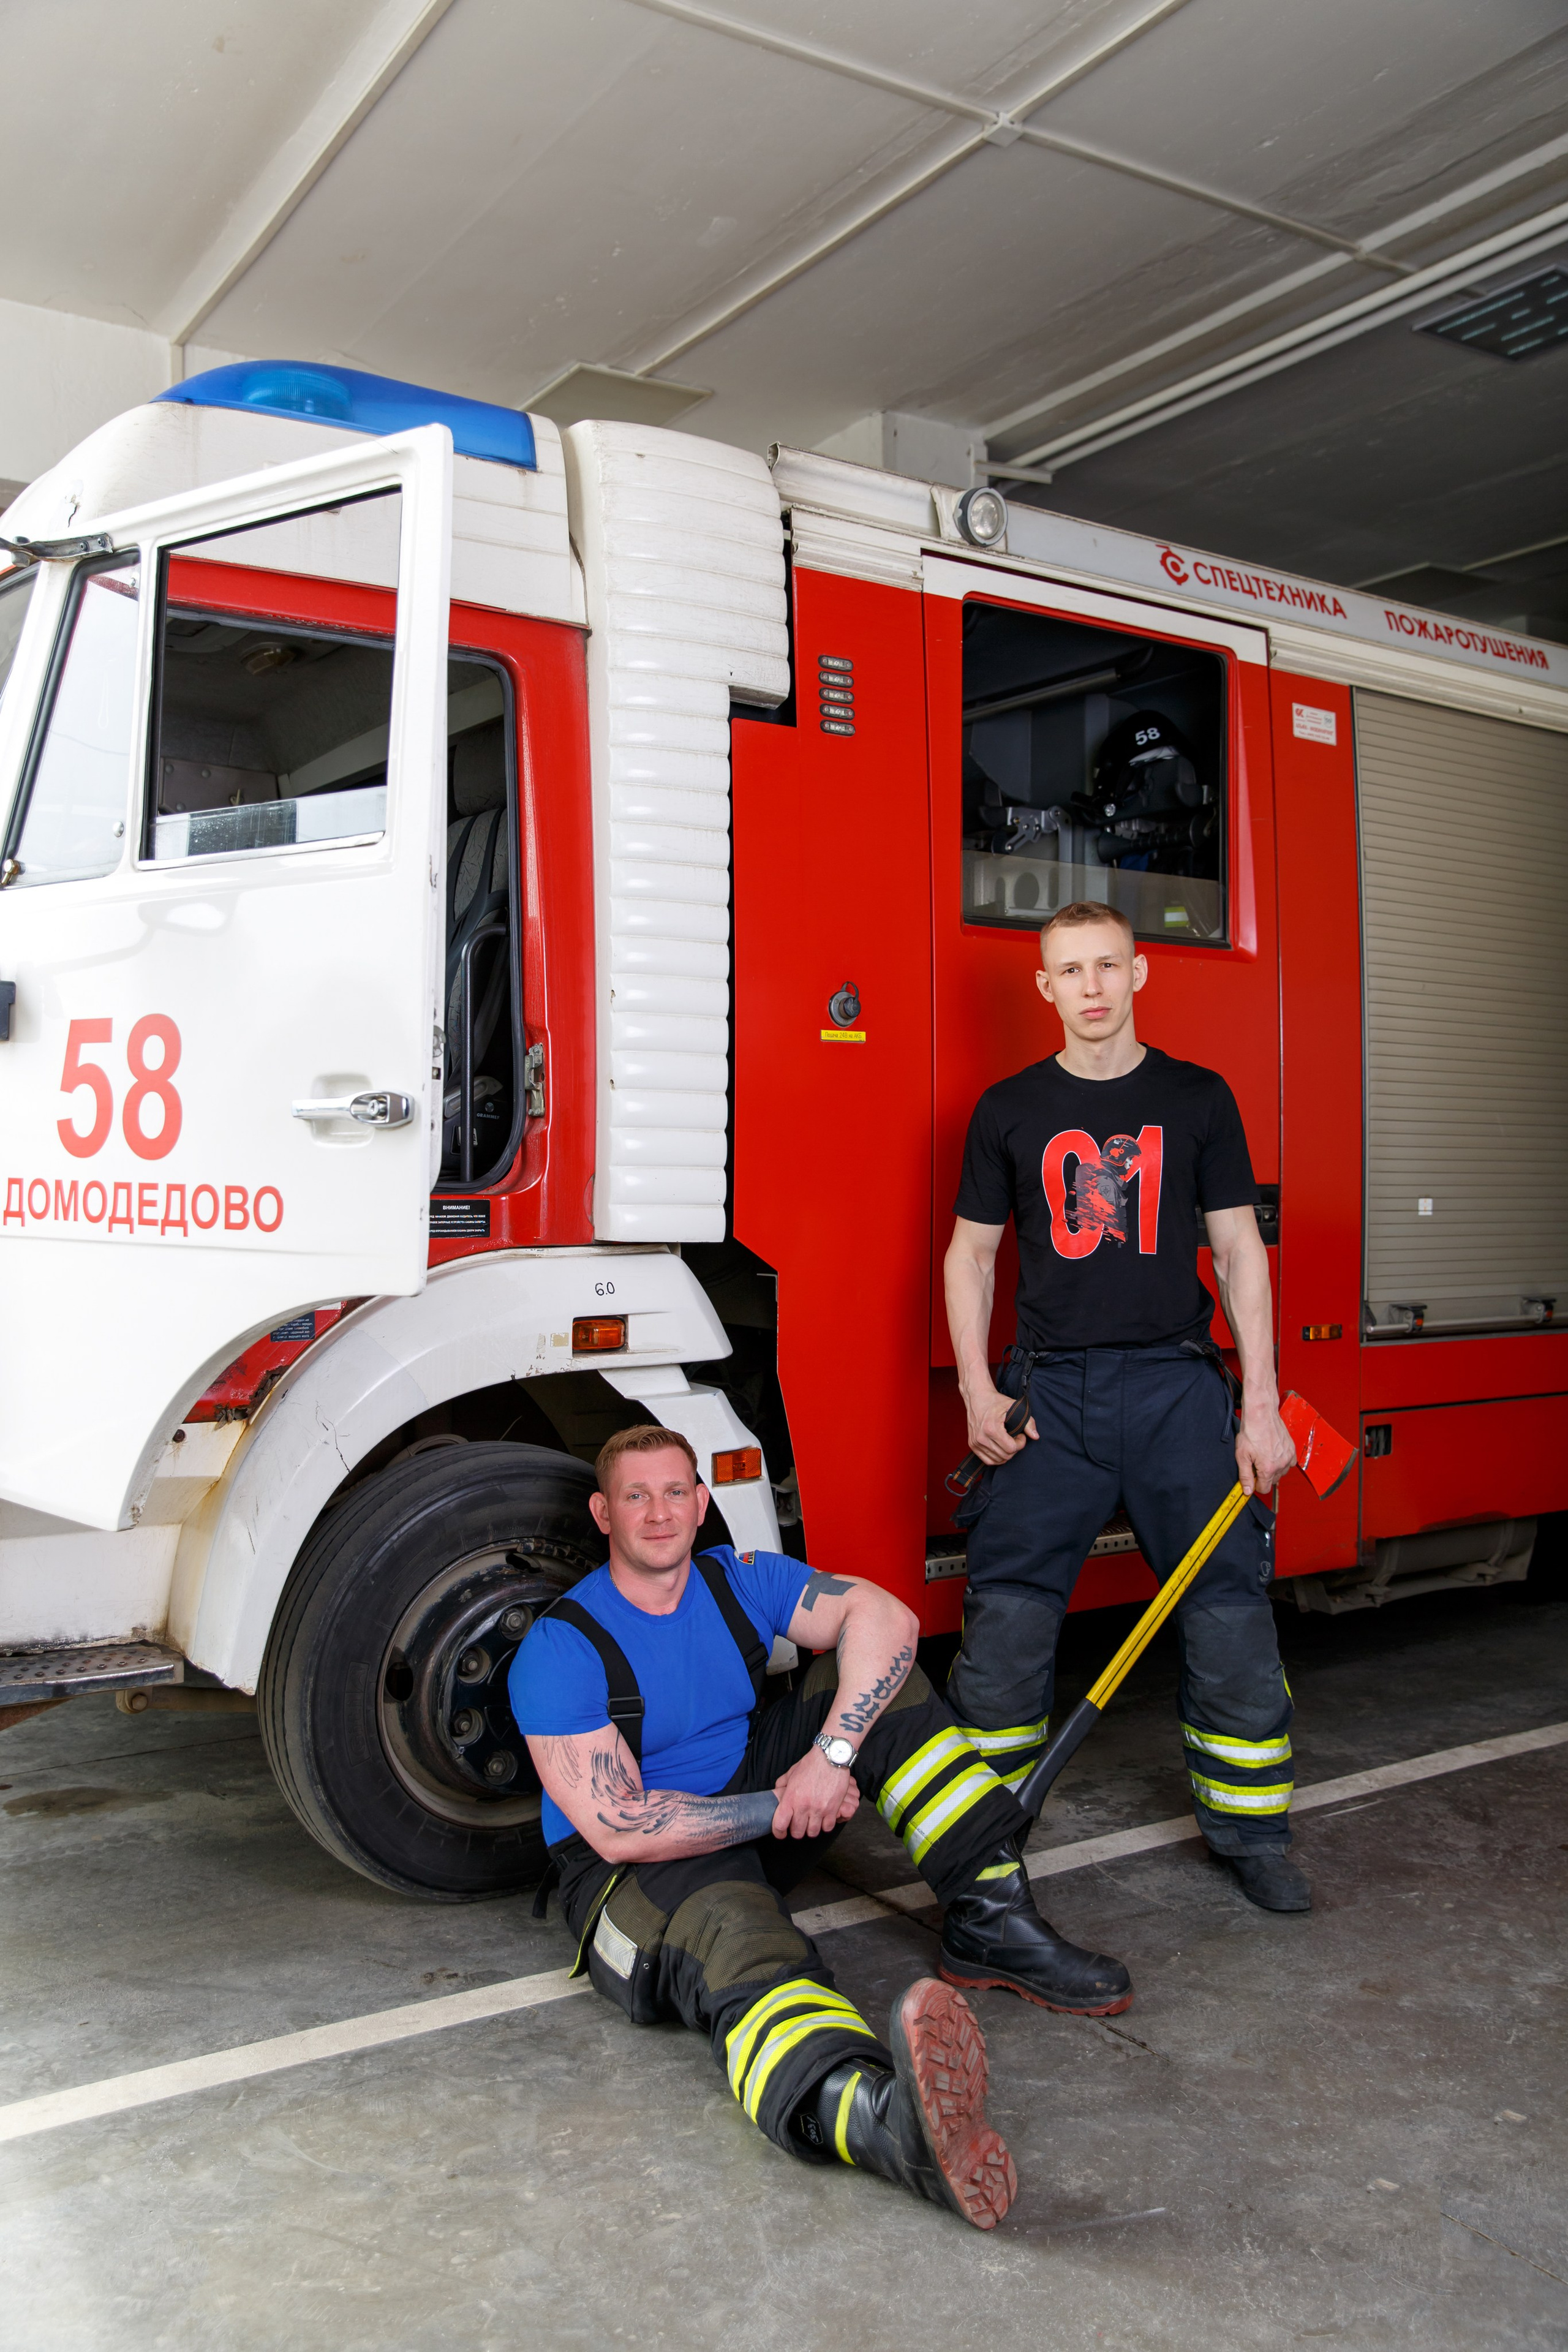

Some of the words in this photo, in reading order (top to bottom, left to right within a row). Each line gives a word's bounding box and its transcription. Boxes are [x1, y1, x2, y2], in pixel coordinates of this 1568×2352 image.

[1193, 562, 1346, 618] СПЕЦТЕХНИКА
[1384, 611, 1549, 669] ПОЖАРОТУШЕНИЯ
[1135, 727, 1161, 745] 58
[57, 1014, 182, 1160] 58
[3, 1178, 284, 1237] ДОМОДЕДОВО
[1042, 1125, 1163, 1259] 01
[595, 1281, 615, 1296] 6.0
